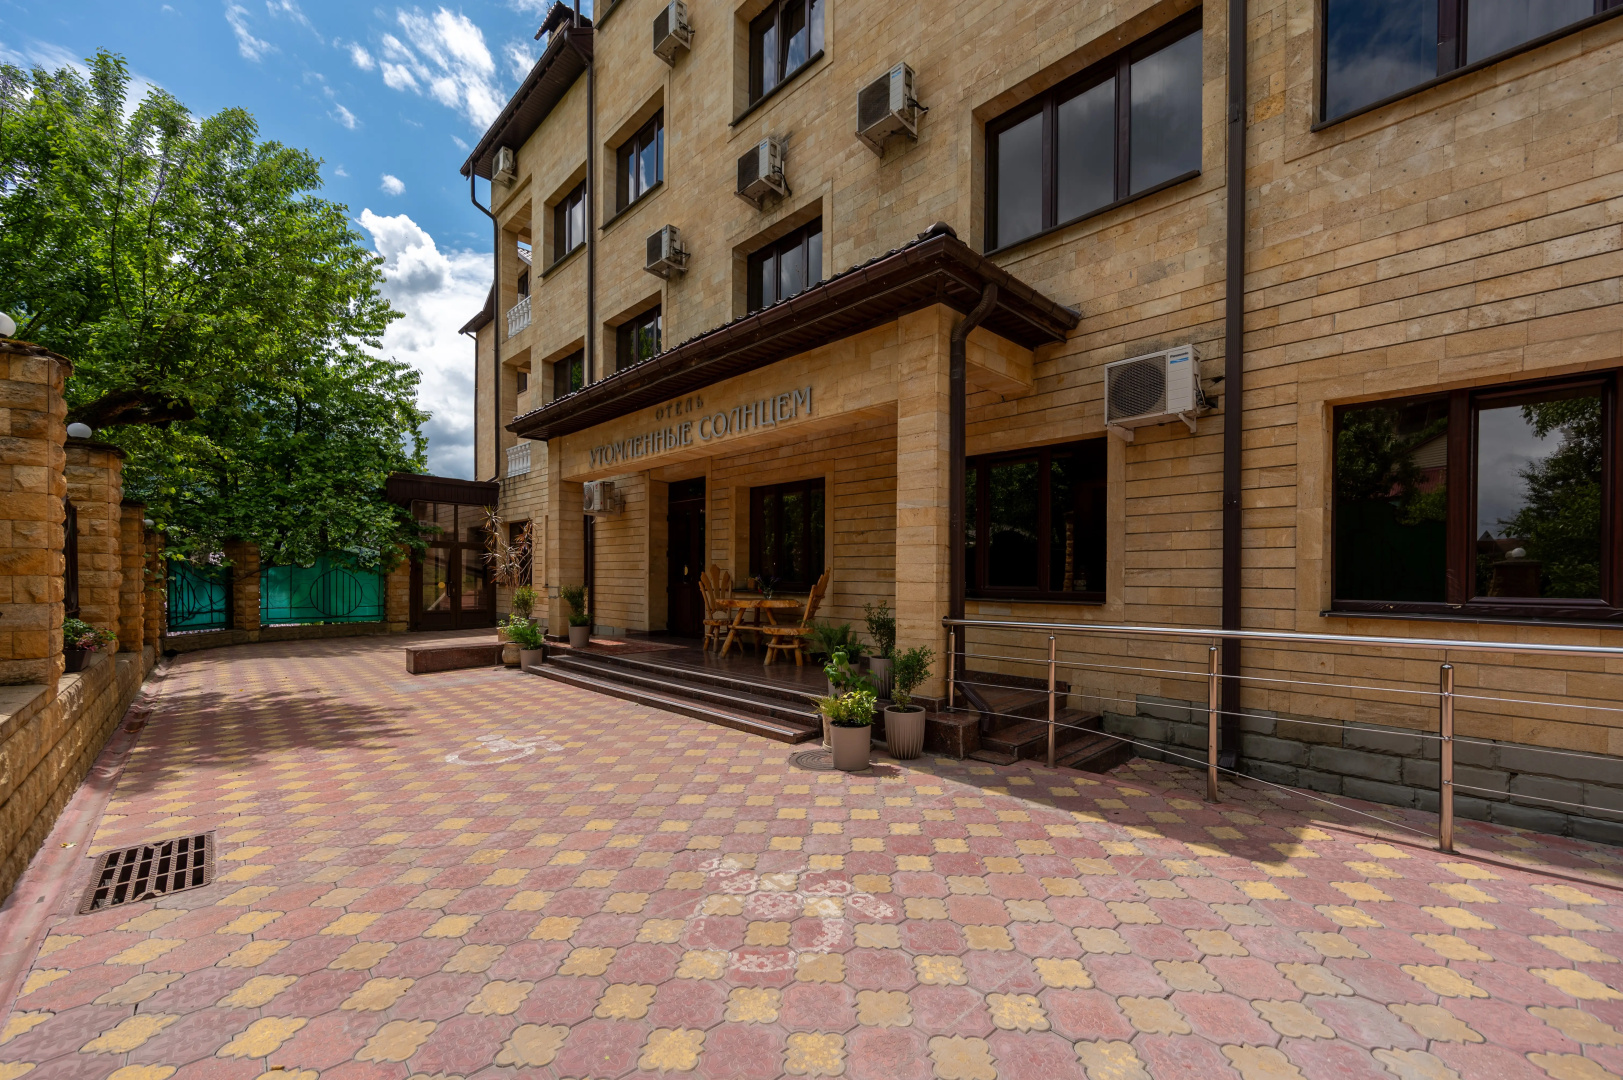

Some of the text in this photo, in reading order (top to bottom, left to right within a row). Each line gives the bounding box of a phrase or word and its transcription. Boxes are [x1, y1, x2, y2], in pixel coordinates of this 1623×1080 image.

[589, 386, 812, 468] УТОМЛЕННЫЕ СОЛНЦЕМ
[655, 395, 704, 421] ОТЕЛЬ
